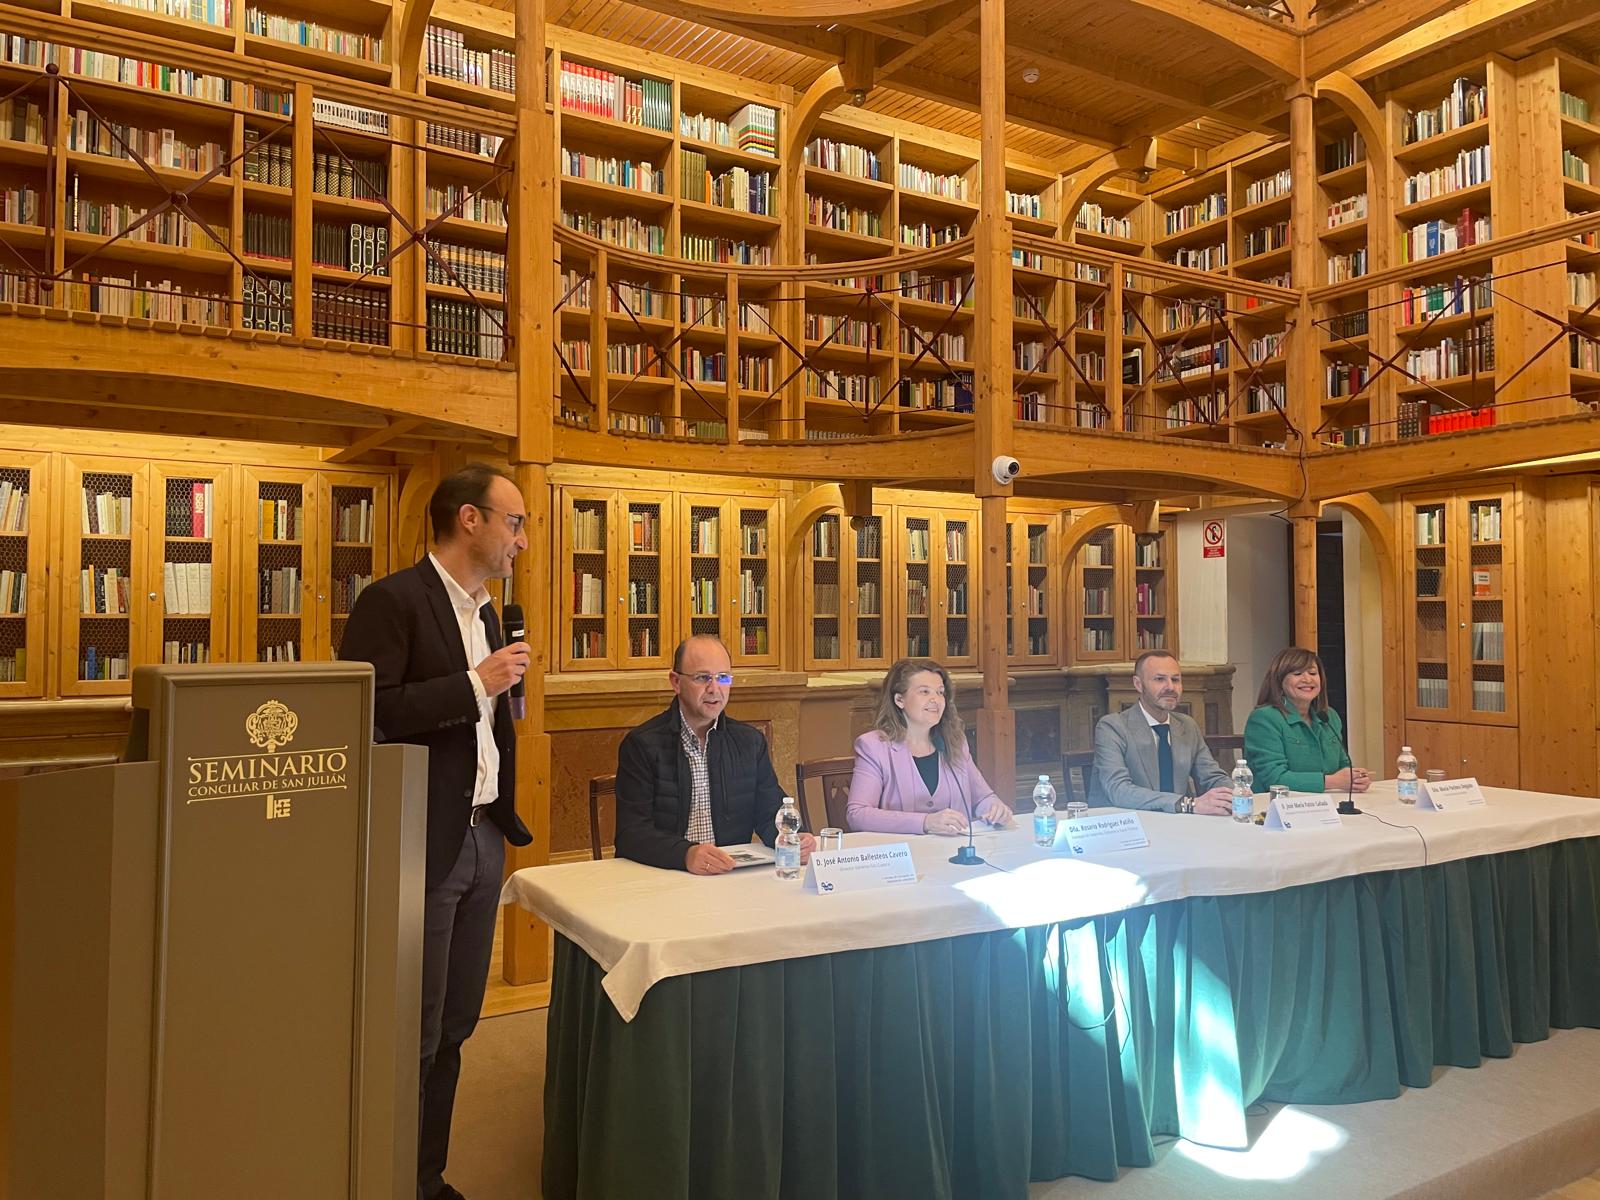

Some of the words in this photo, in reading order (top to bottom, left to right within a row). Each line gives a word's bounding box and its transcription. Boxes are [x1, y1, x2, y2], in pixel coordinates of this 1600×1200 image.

[195, 492, 204, 514] ISBN
[189, 752, 347, 784] SEMINARIO
[187, 781, 260, 798] CONCILIAR
[262, 779, 279, 791] DE
[281, 778, 304, 790] SAN
[307, 773, 346, 788] JULIÁN
[823, 857, 836, 868] José
[837, 856, 860, 864] Antonio
